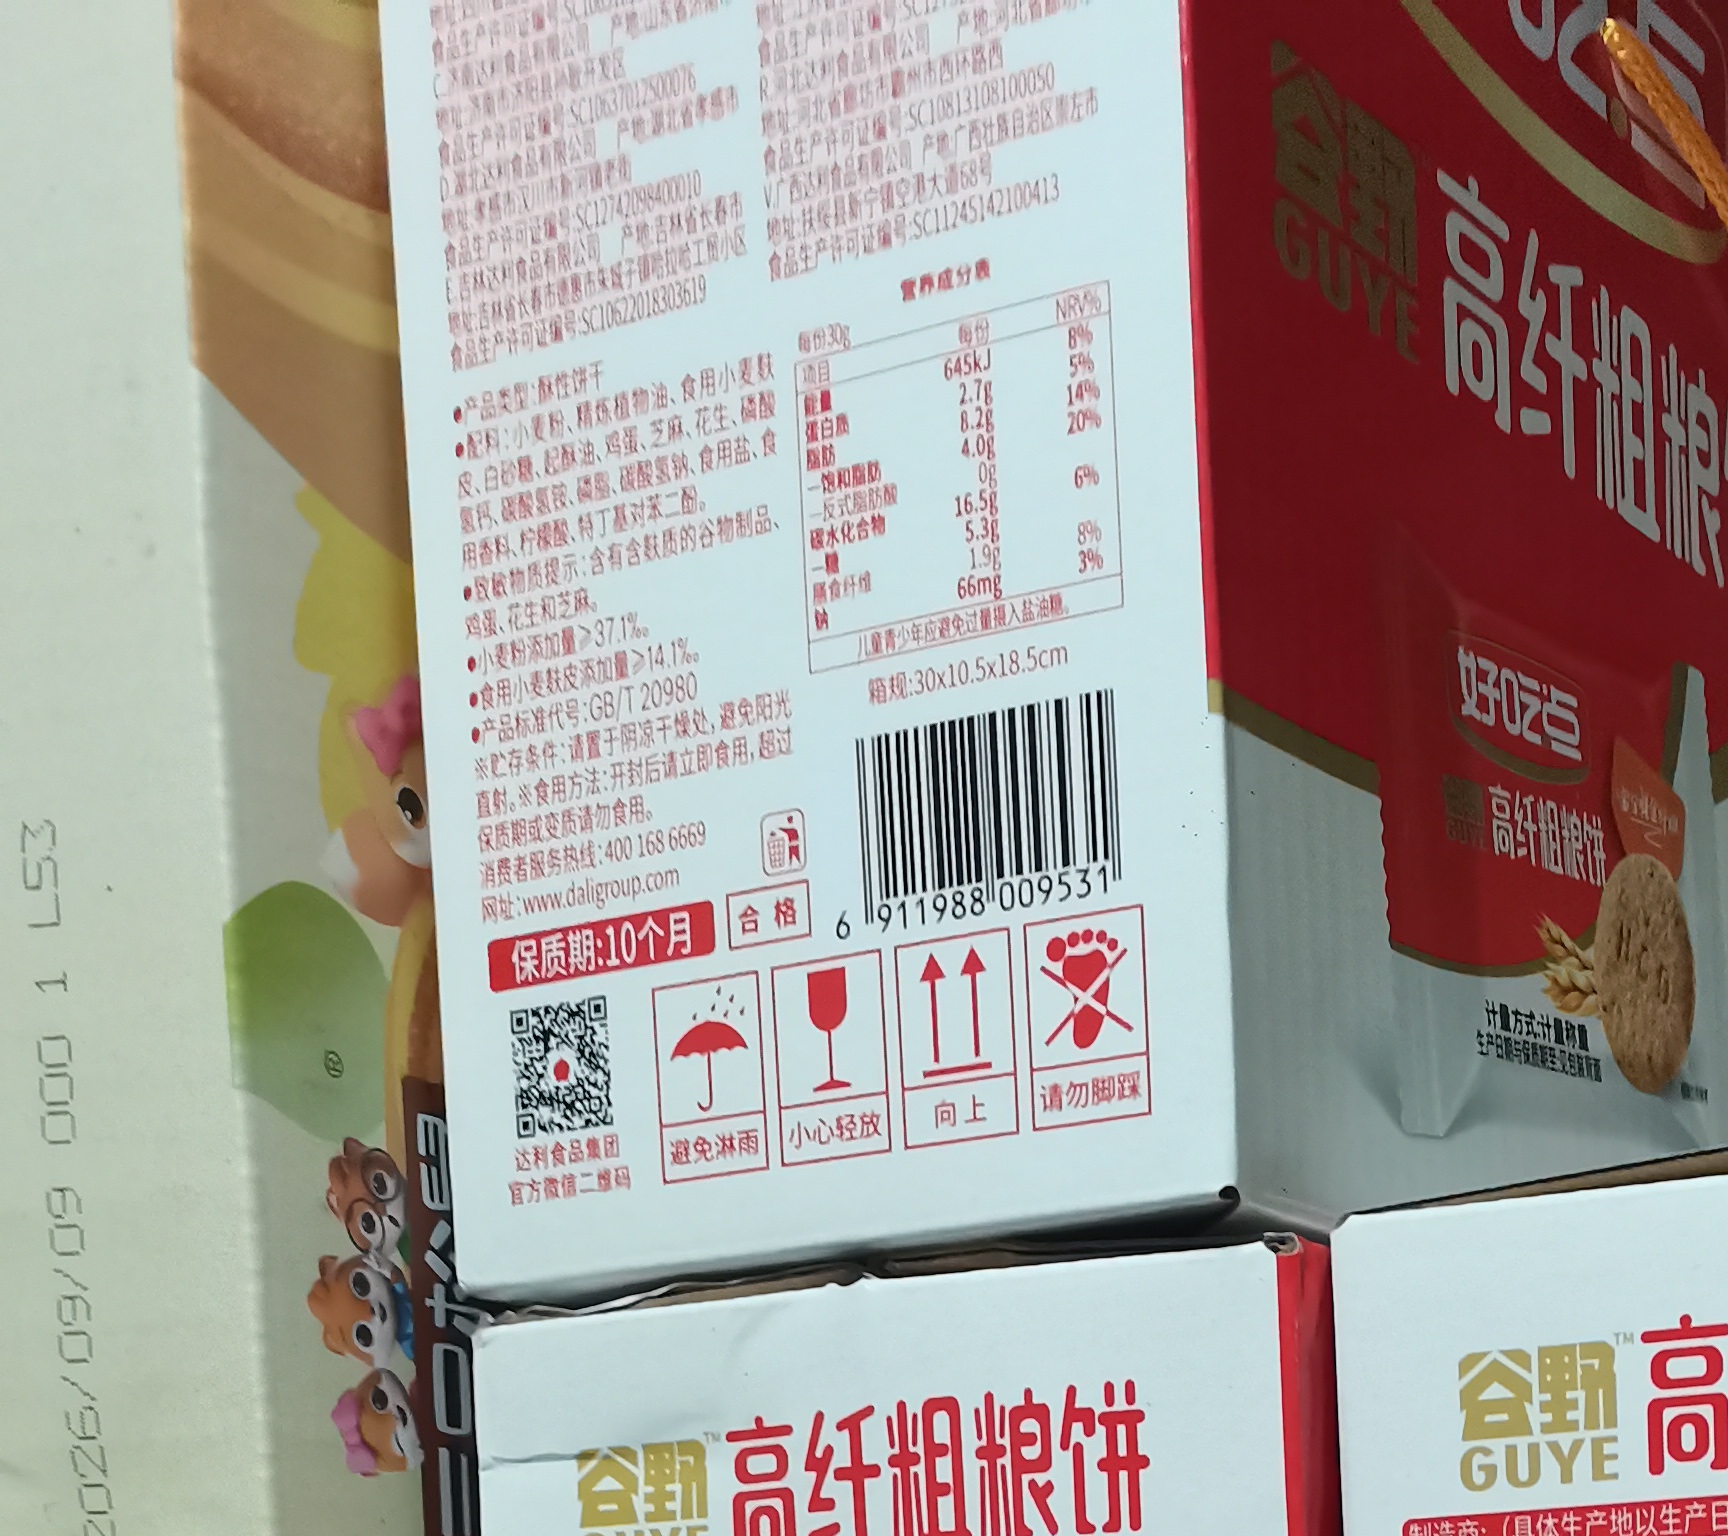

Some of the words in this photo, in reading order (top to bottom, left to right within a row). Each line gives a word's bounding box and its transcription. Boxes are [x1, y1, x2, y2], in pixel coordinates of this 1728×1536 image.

[1457, 645, 1583, 762] 好吃点
[835, 910, 851, 940] 6
[878, 887, 987, 933] 911988
[999, 866, 1112, 912] 009531
[511, 911, 694, 986] 保质期:10个月
[785, 1108, 887, 1151] 小心轻放
[1037, 1069, 1146, 1117] 请勿脚踩
[1458, 1341, 1618, 1441] 谷野
[1459, 1437, 1620, 1492] GUYE
